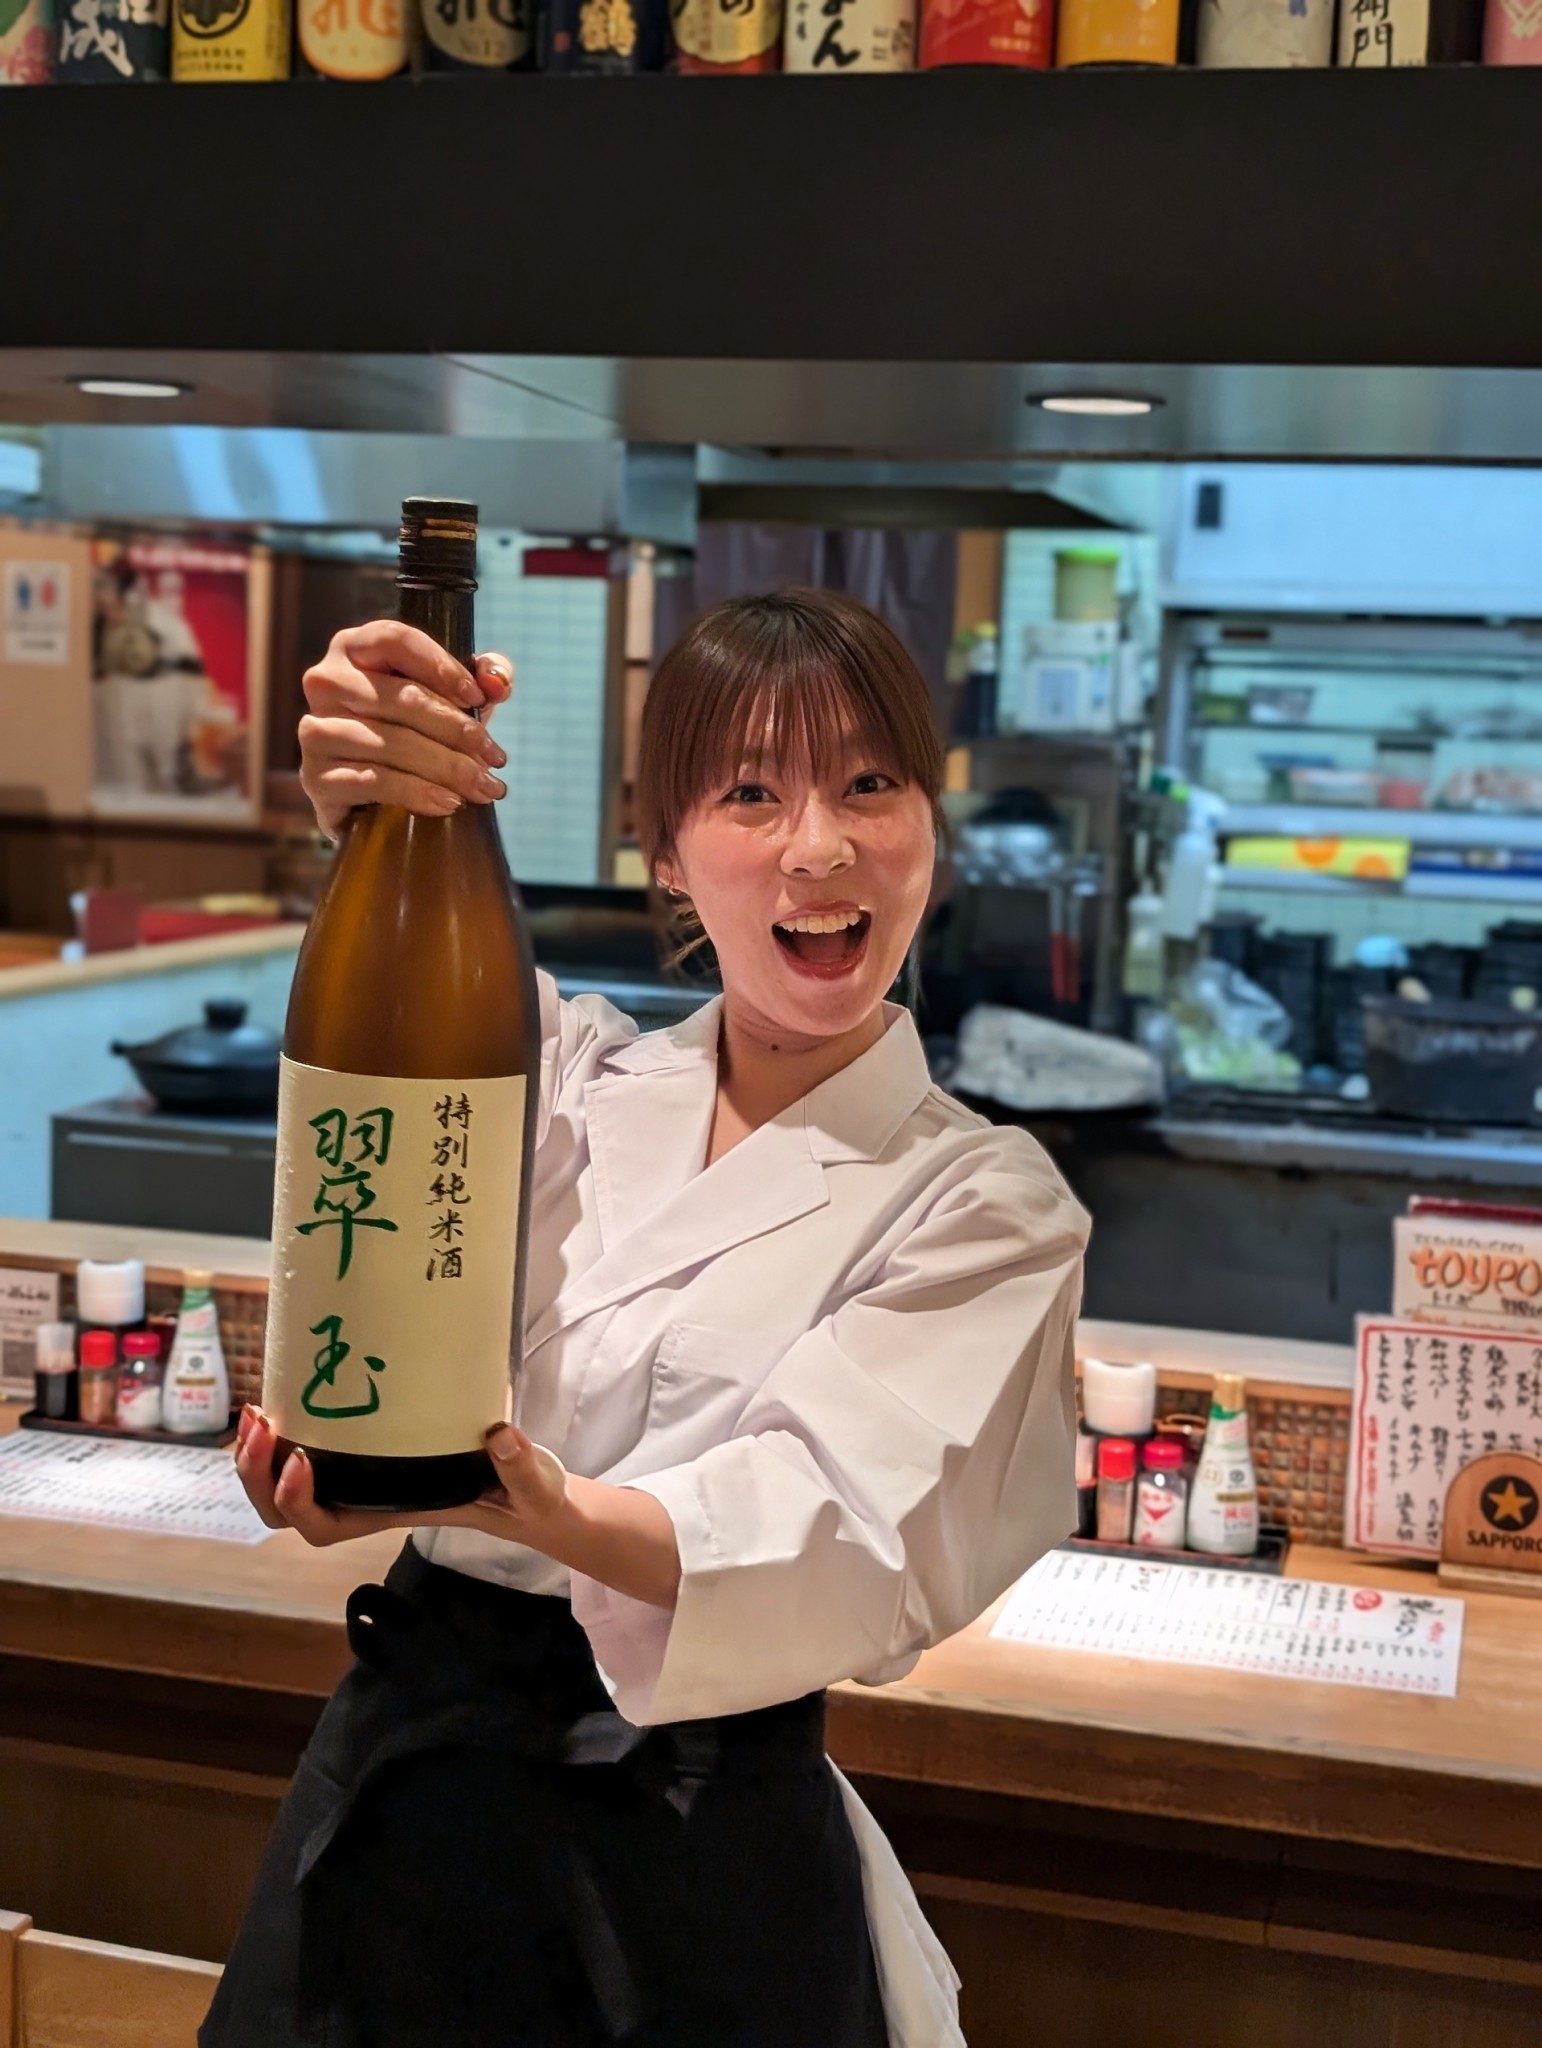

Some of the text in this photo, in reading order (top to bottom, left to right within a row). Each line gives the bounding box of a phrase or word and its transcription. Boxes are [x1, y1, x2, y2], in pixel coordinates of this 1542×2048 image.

[295, 1107, 399, 1418] 翠玉
[426, 1092, 474, 1281] 特別純米酒
[1466, 1530, 1542, 1553] SAPPORO
